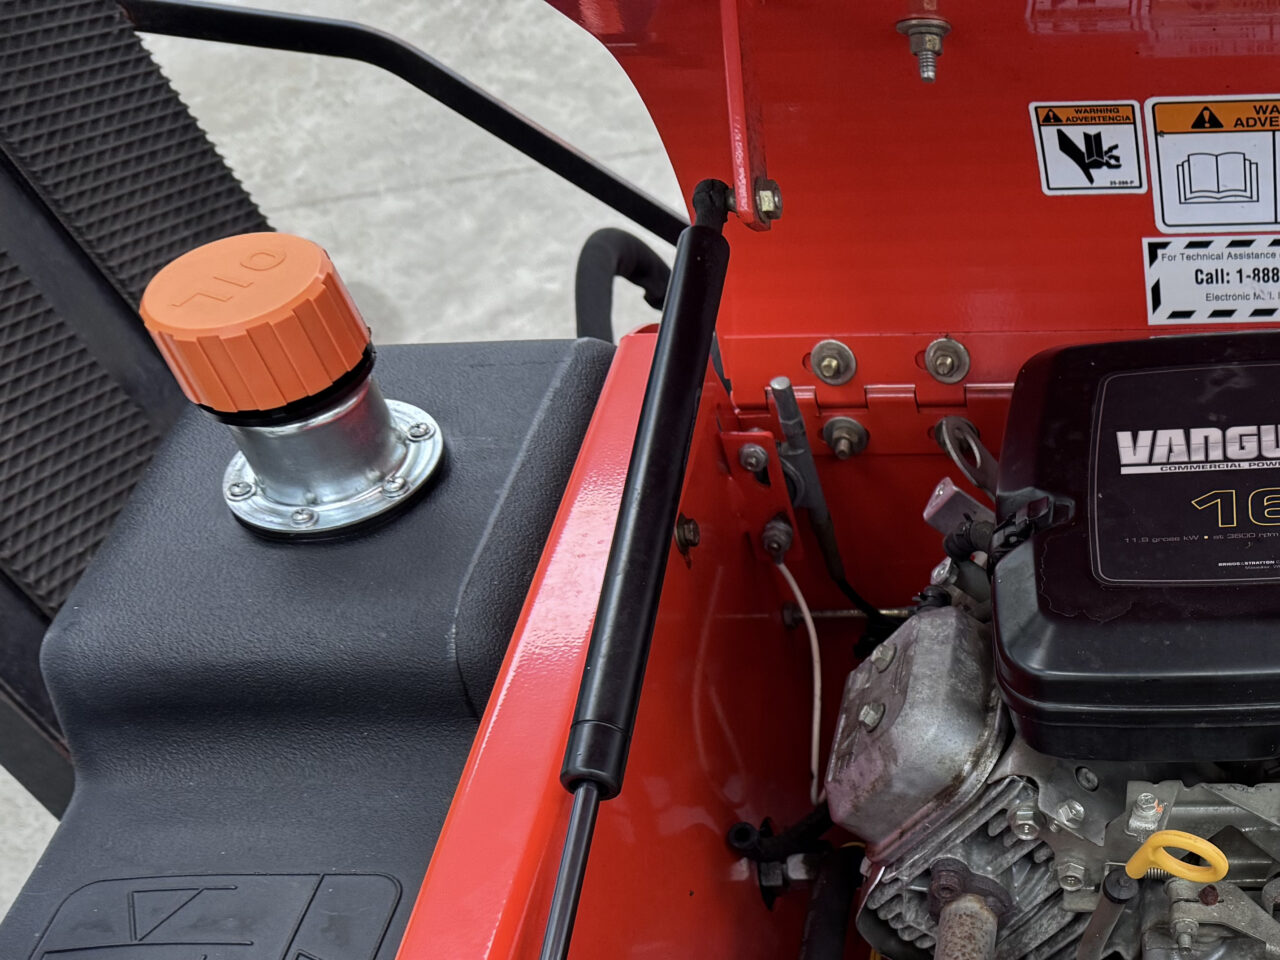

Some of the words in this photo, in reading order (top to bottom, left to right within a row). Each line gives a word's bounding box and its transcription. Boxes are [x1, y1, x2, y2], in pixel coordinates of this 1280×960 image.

[1074, 107, 1120, 115] WARNING
[1065, 115, 1132, 123] ADVERTENCIA
[1161, 253, 1177, 261] For
[1180, 252, 1224, 261] Technical
[1226, 251, 1276, 260] Assistance
[1194, 267, 1230, 285] Call:
[1205, 292, 1251, 302] Electronic
[1160, 463, 1242, 472] COMMERCIAL
